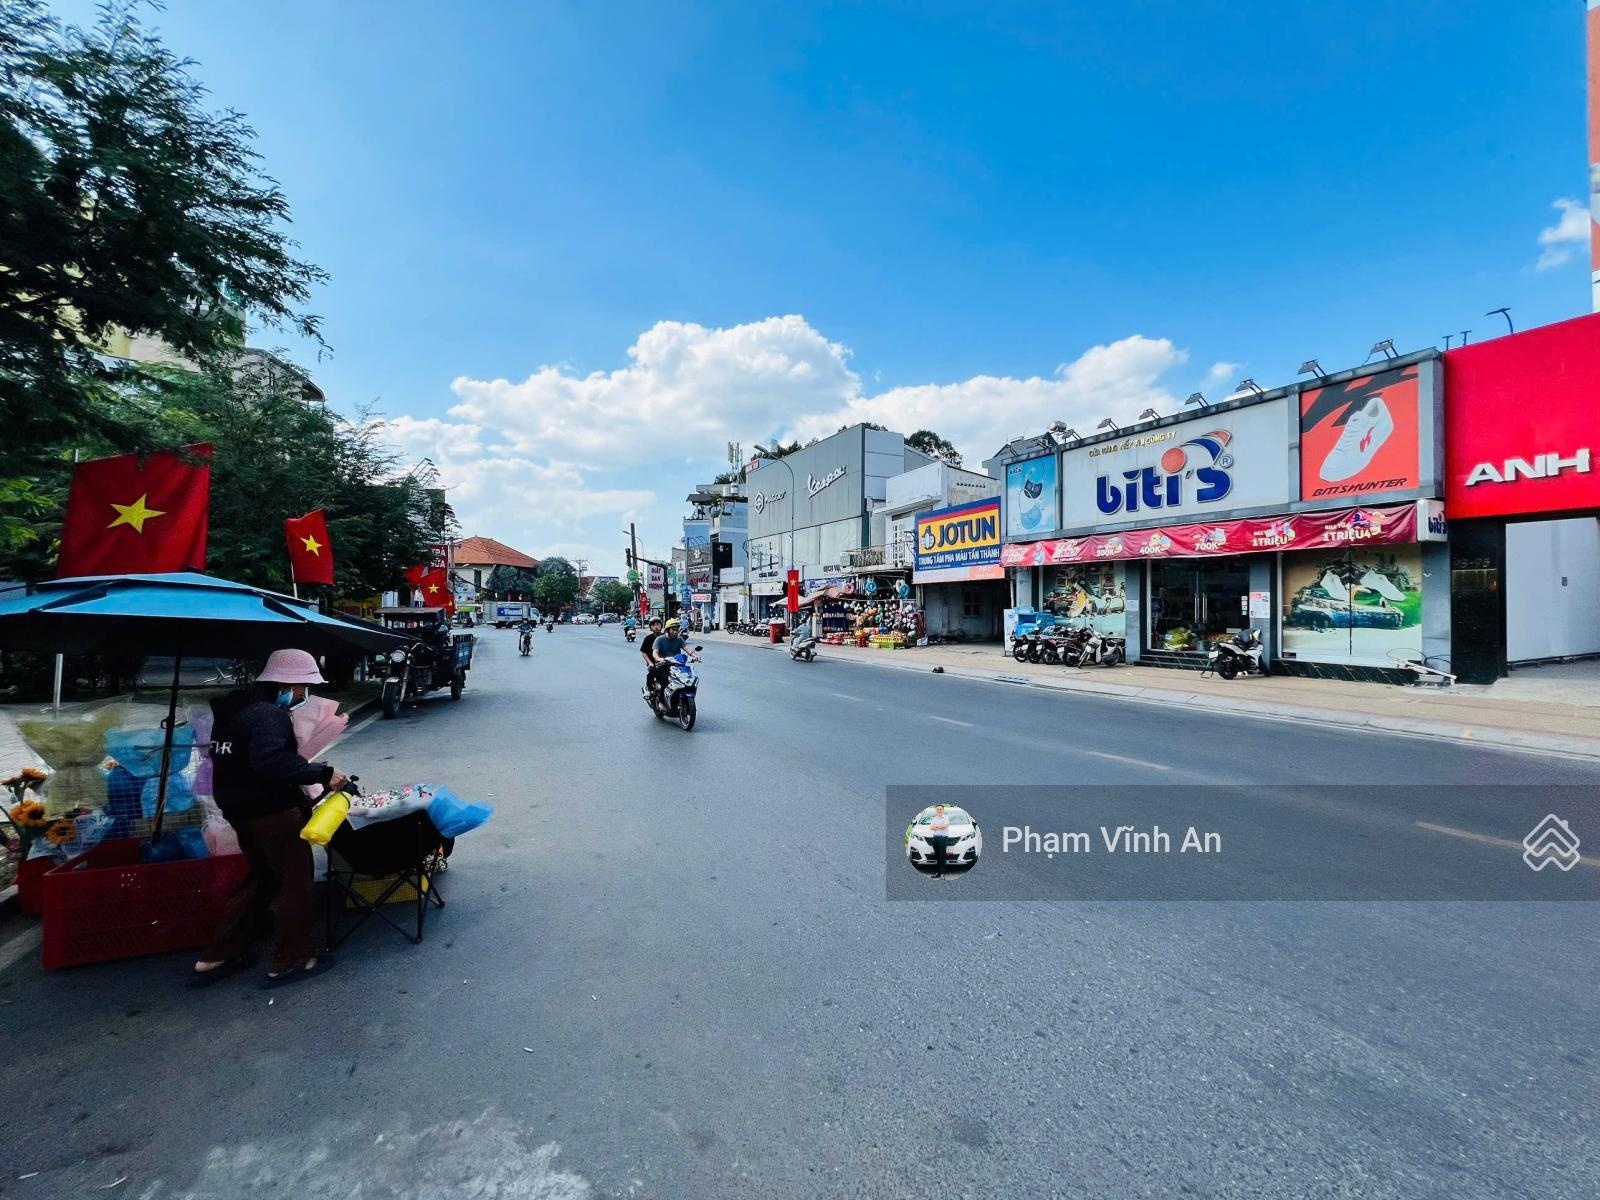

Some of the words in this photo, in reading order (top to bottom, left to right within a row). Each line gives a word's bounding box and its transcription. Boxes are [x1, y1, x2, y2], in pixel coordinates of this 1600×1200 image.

[1167, 431, 1177, 440] TY
[1464, 448, 1591, 485] ANH
[1349, 478, 1407, 491] HUNTER
[937, 515, 996, 548] JOTUN
[1140, 545, 1161, 554] 400K
[1194, 542, 1218, 551] 700K
[955, 550, 968, 561] MÀU
[980, 547, 1000, 558] THÀNH
